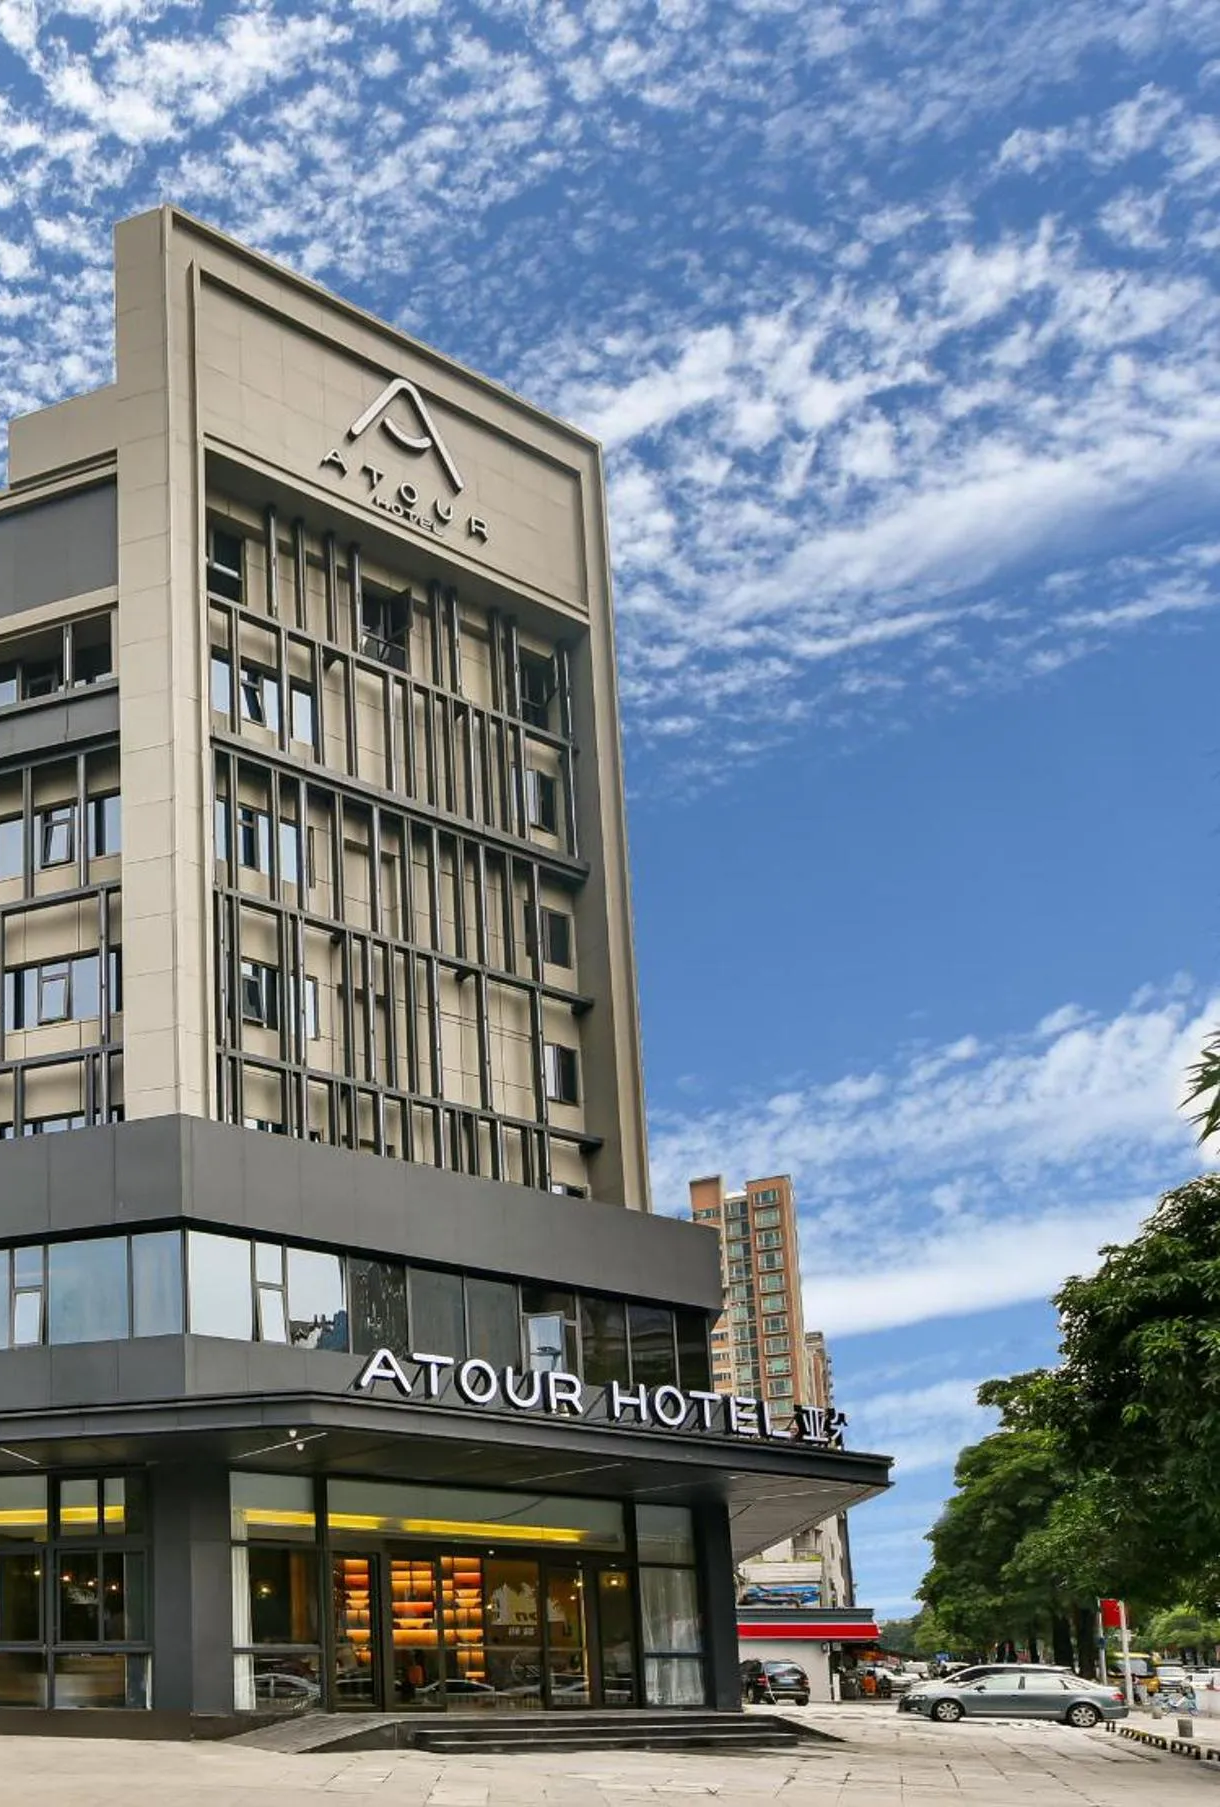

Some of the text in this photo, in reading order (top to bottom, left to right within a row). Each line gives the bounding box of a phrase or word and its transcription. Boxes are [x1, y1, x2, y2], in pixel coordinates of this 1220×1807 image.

[320, 448, 489, 543] ATOUR
[372, 496, 444, 538] HOTEL
[358, 1348, 584, 1415] ATOUR
[612, 1379, 792, 1439] HOTEL
